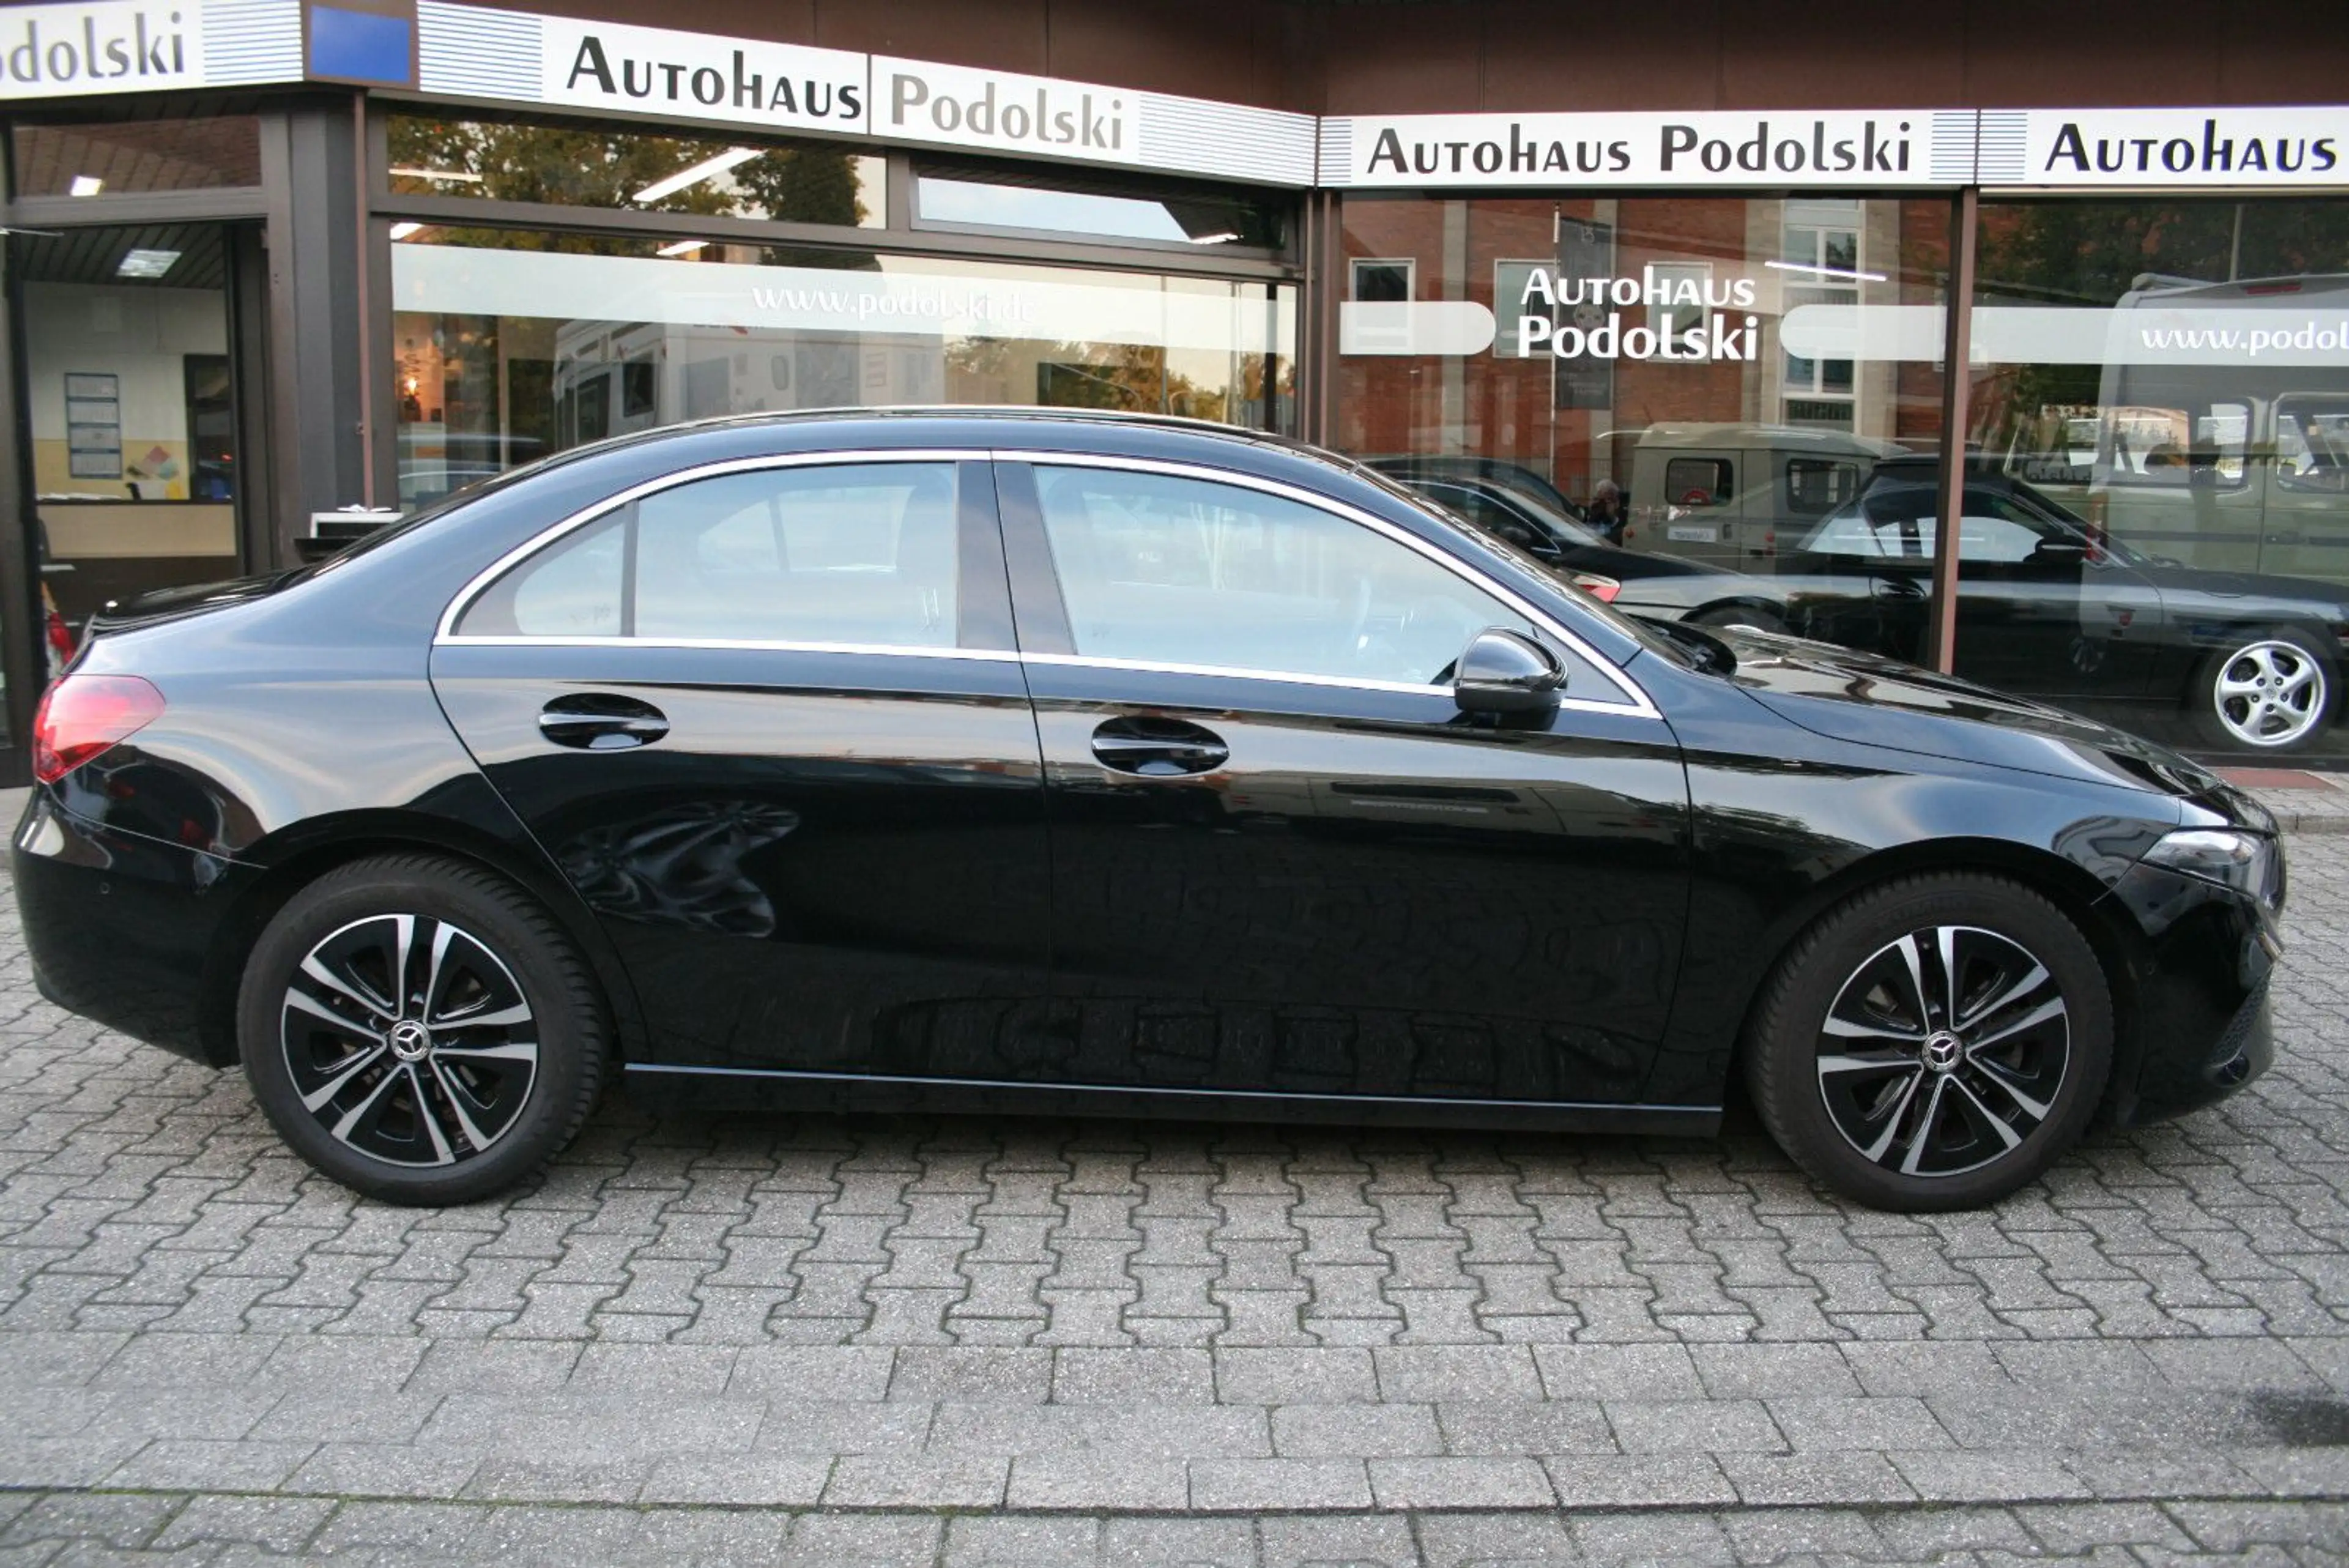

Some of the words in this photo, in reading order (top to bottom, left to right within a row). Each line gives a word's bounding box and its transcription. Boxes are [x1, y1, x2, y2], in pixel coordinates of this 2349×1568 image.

[0, 11, 184, 83] dolski
[891, 73, 1122, 150] Podolski
[1660, 120, 1910, 172] Podolski
[1518, 311, 1758, 360] Podolski
